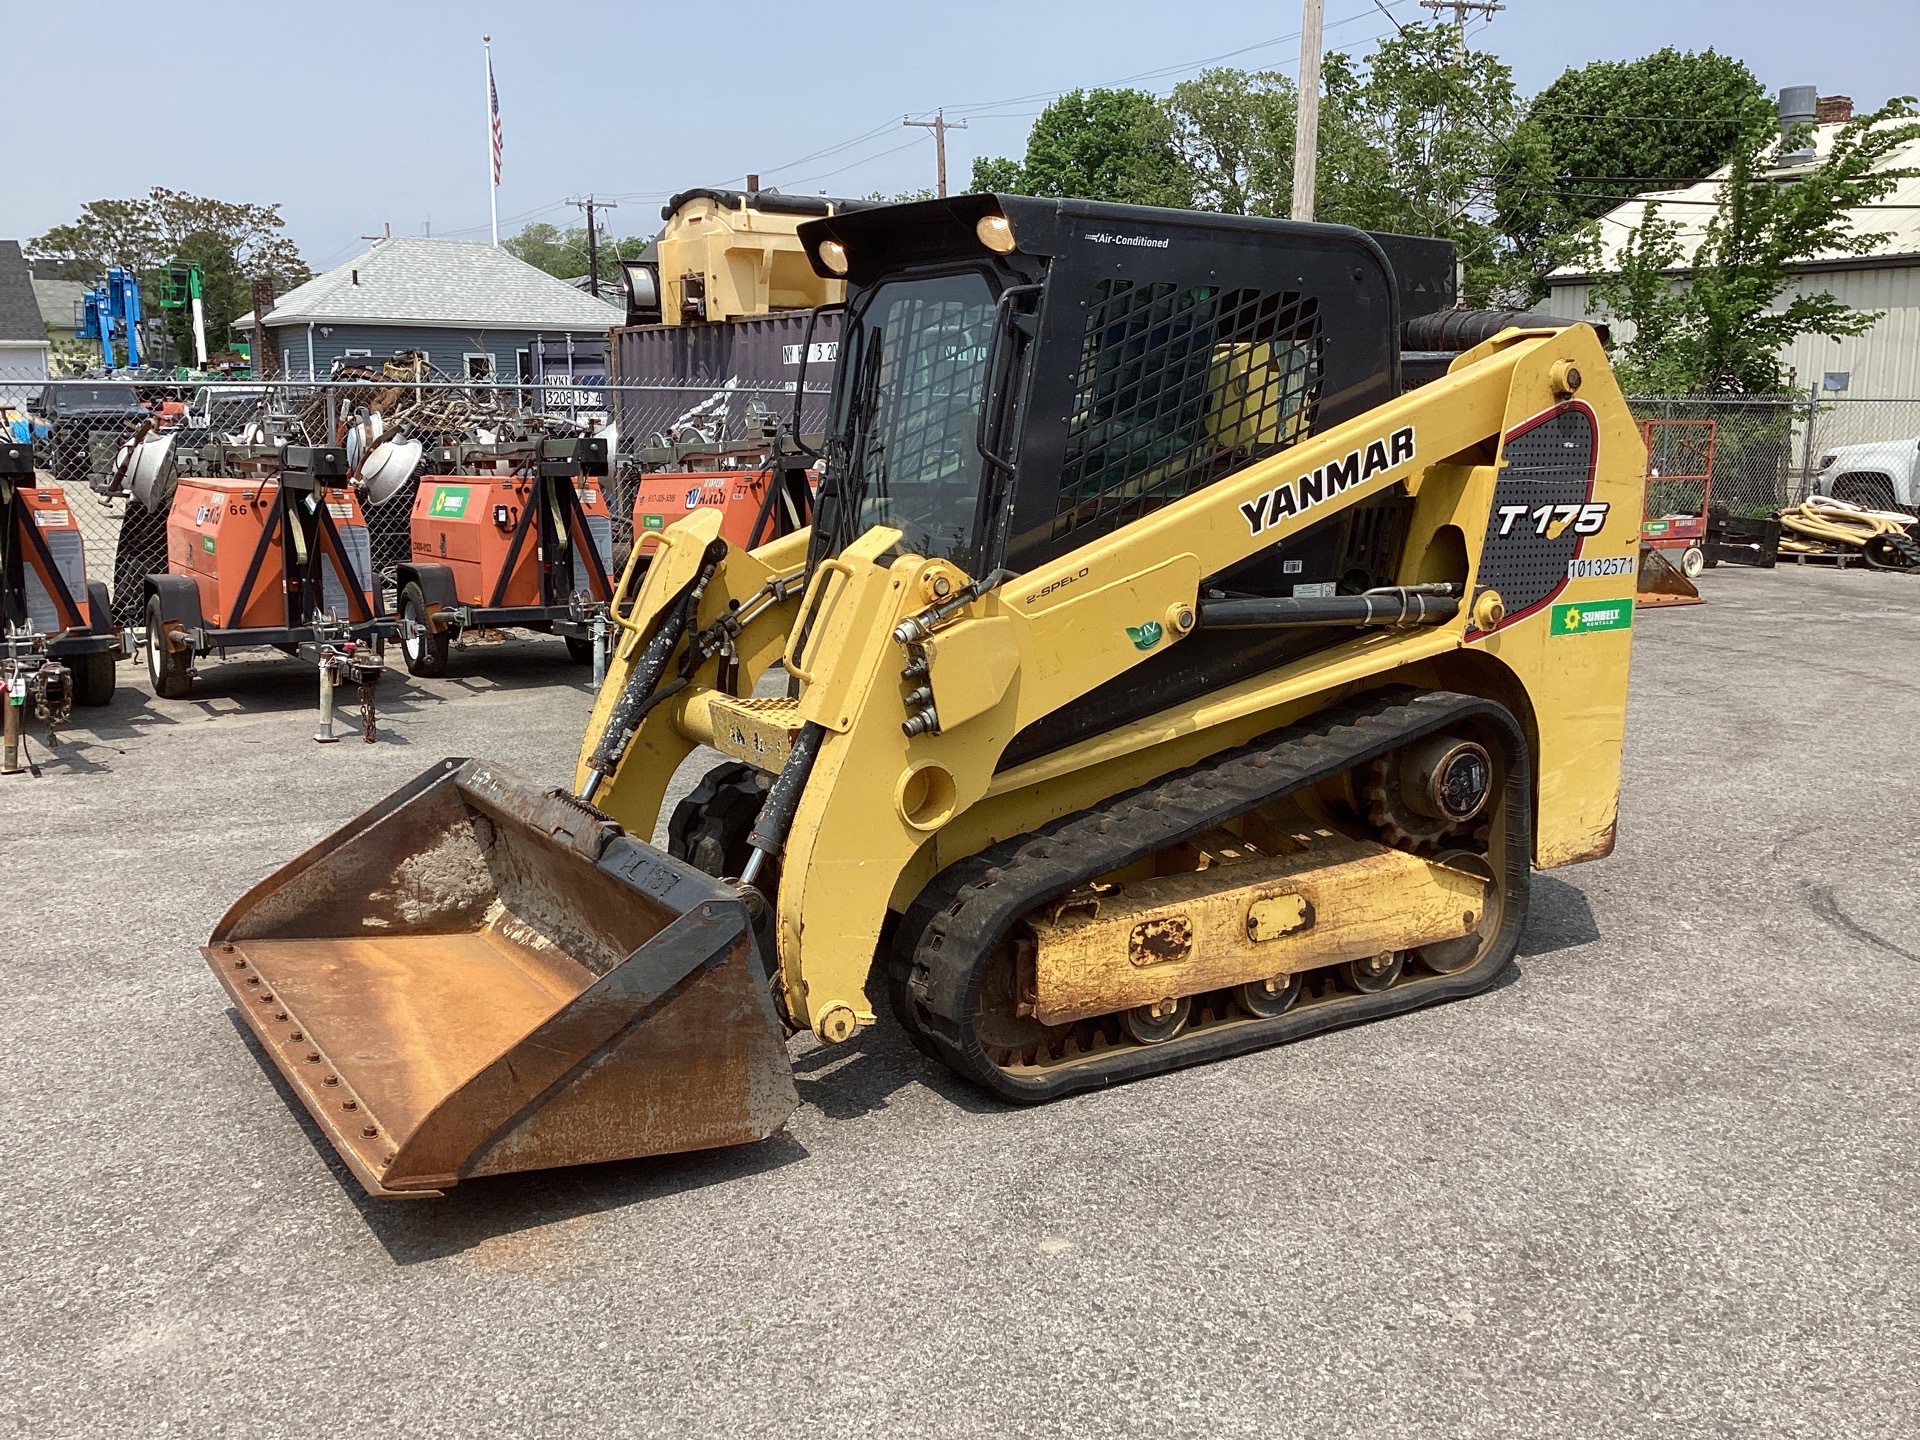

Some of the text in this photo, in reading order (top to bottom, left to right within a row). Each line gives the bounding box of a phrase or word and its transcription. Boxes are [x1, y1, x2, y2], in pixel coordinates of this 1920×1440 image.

[1098, 233, 1169, 248] Air-Conditioned
[1239, 426, 1415, 535] YANMAR
[230, 504, 247, 515] 66
[1569, 556, 1634, 578] 10132571
[1581, 609, 1620, 622] SUNBELT
